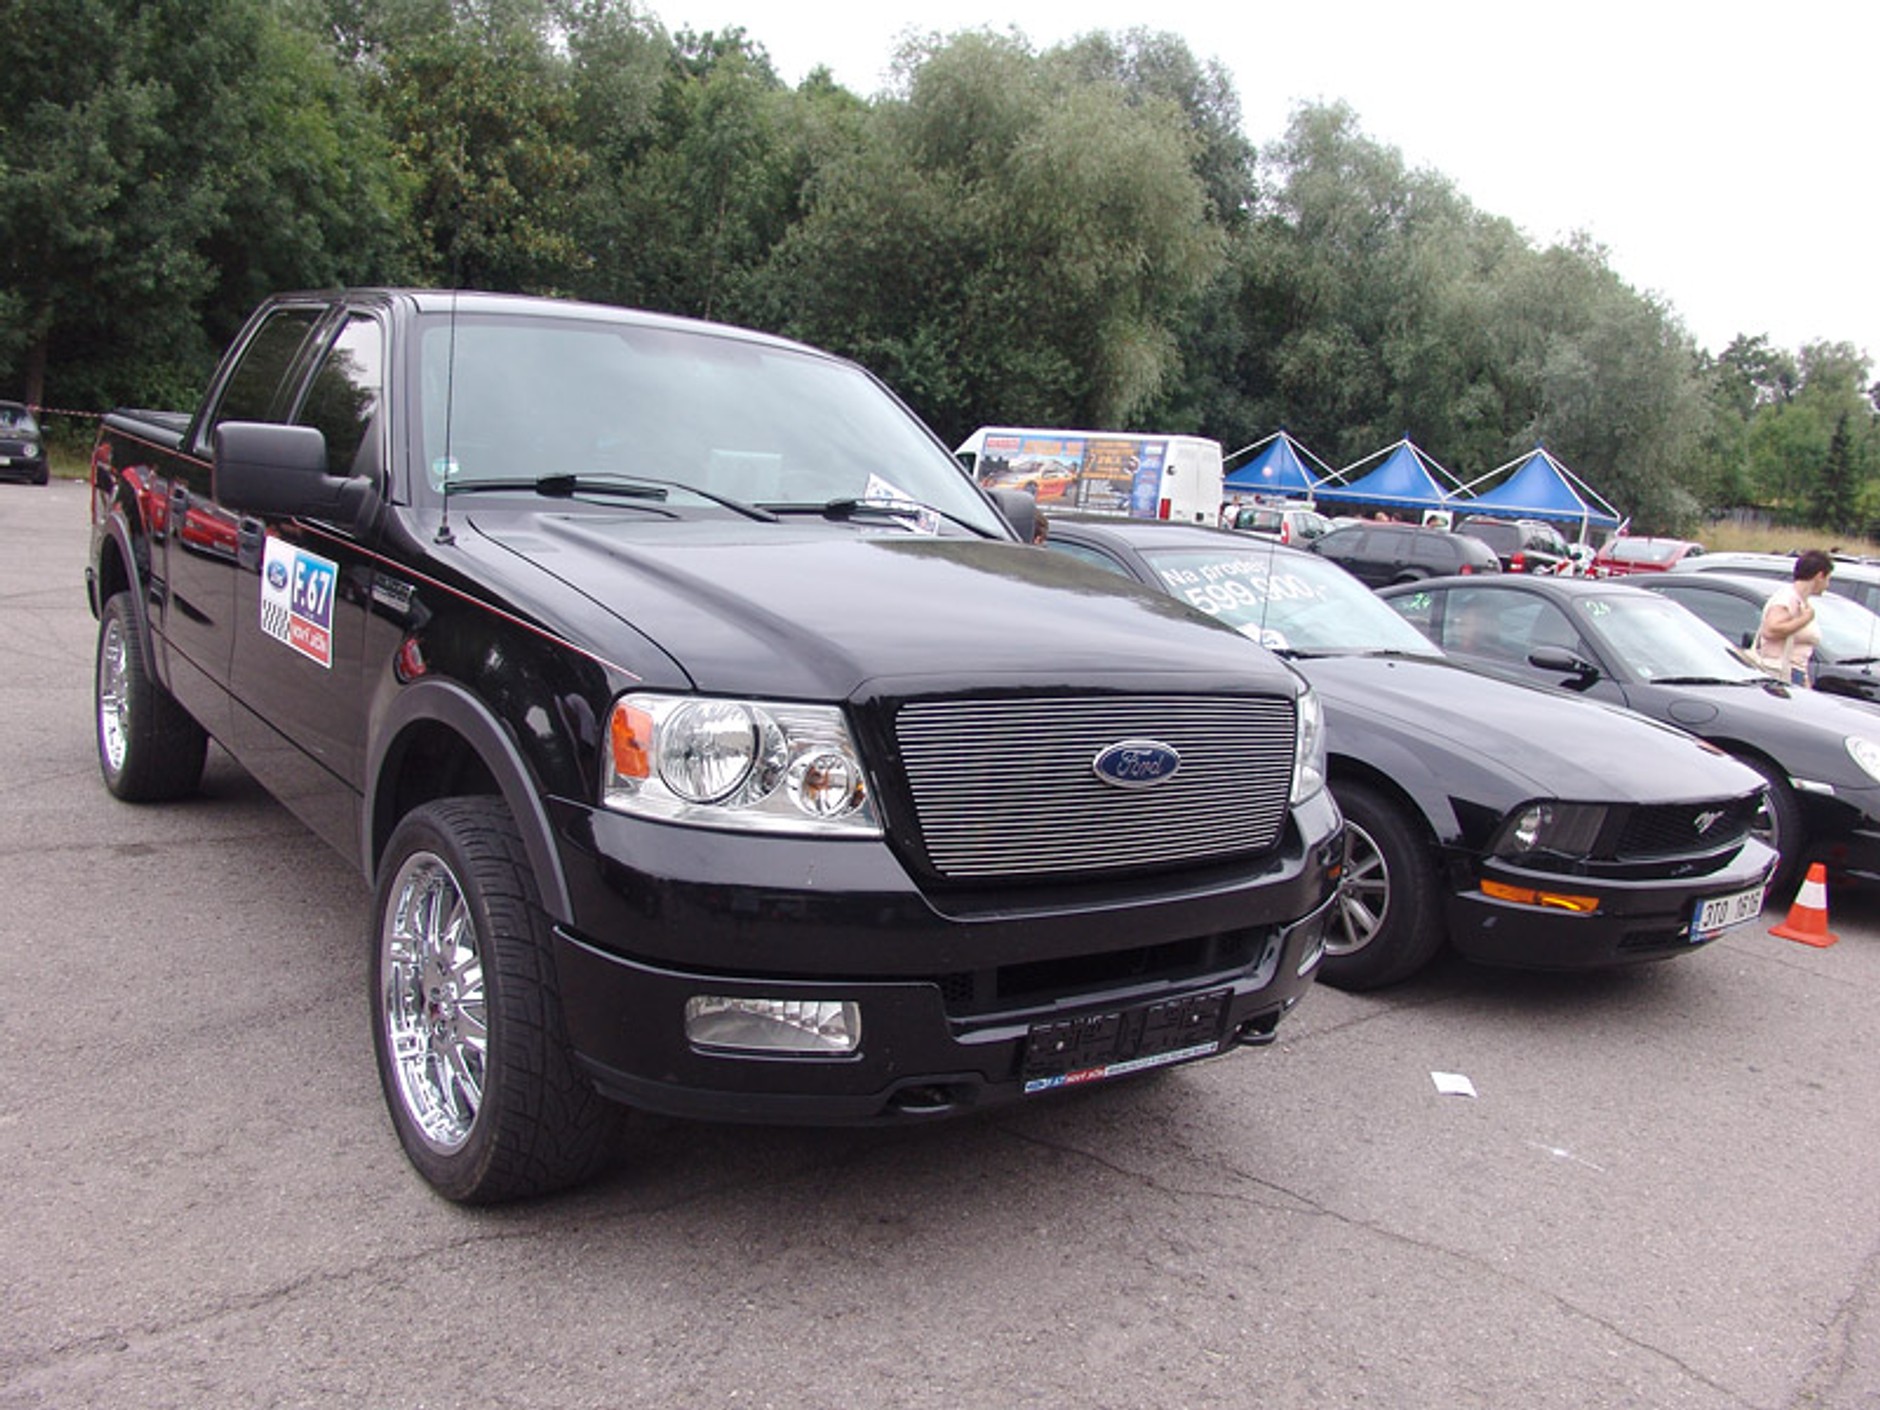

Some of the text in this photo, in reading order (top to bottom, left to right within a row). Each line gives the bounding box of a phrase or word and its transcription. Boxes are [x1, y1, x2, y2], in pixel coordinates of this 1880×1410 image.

[293, 561, 330, 615] F.67
[1161, 568, 1200, 587] Na
[1116, 748, 1165, 777] Ford
